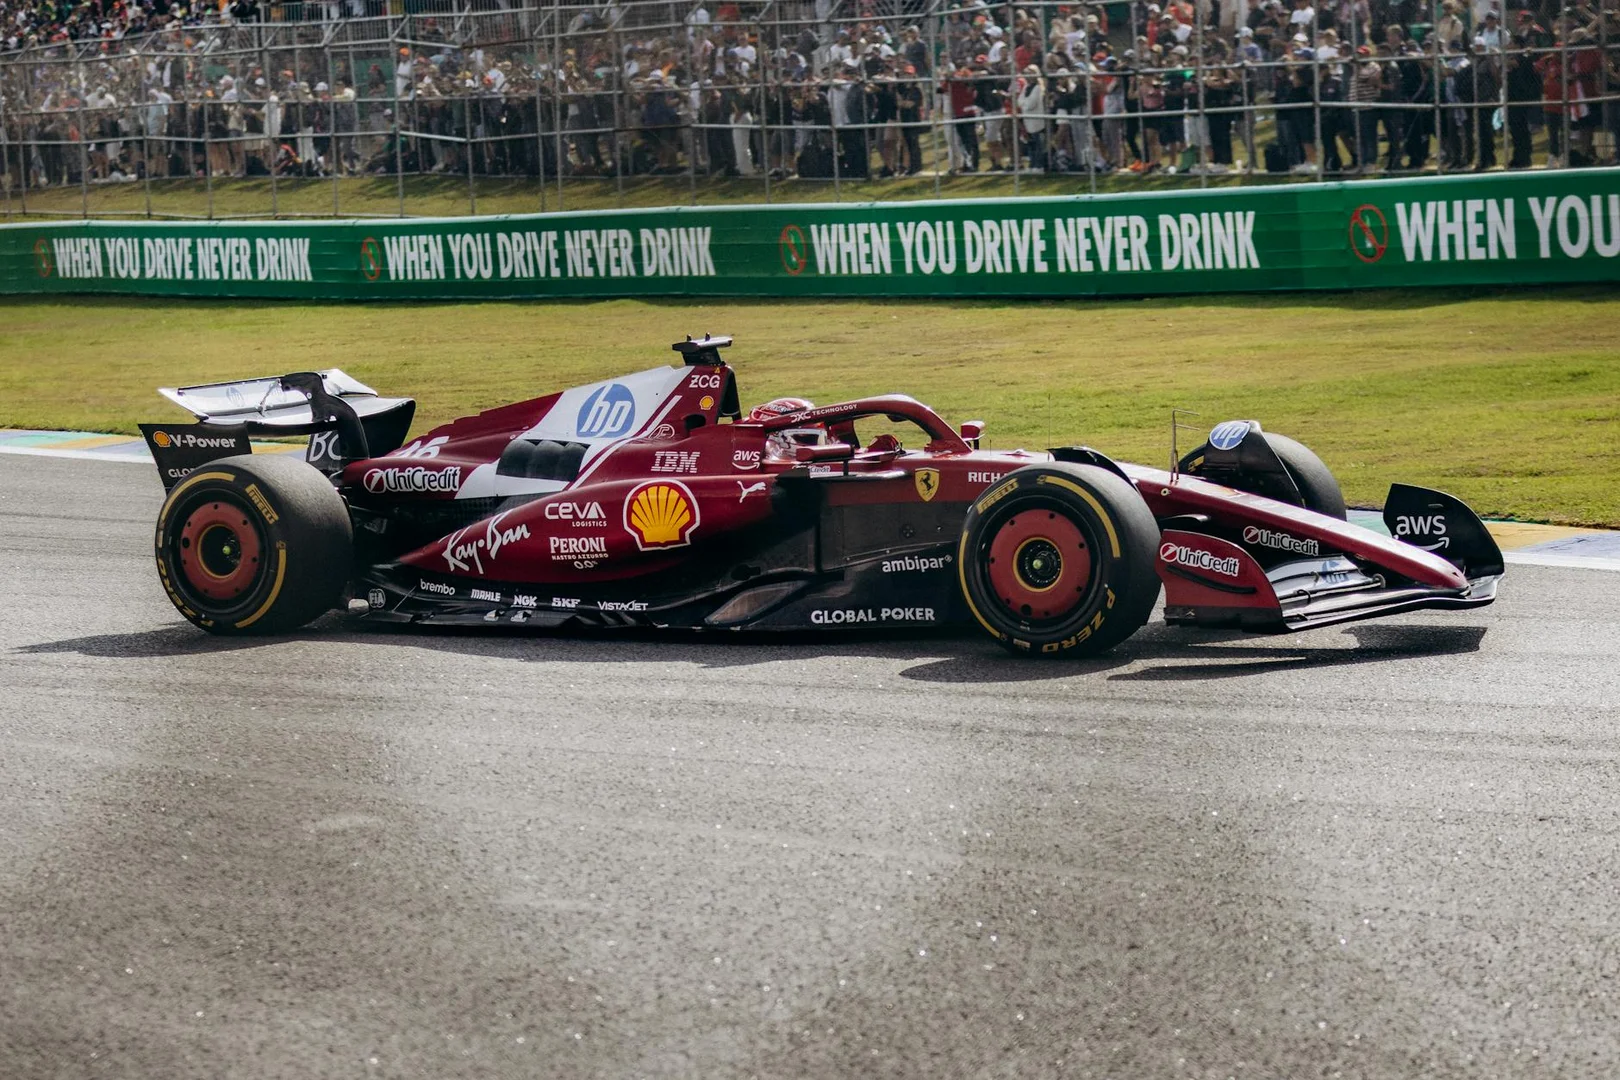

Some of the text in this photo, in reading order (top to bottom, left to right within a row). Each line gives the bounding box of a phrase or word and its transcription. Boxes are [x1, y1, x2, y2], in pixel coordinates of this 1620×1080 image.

[1395, 194, 1620, 262] WHEN YOU
[810, 211, 1260, 275] WHEN YOU DRIVE NEVER DRINK
[52, 237, 313, 281] WHEN YOU DRIVE NEVER DRINK
[383, 226, 716, 281] WHEN YOU DRIVE NEVER DRINK
[688, 374, 721, 389] ZCG
[580, 384, 634, 438] hp
[812, 403, 858, 417] TECHNOLOGY
[169, 433, 236, 448] V-Power
[1213, 422, 1246, 449] hp
[650, 451, 701, 474] IBM
[733, 450, 761, 461] aws
[384, 466, 461, 492] UniCredit
[571, 520, 608, 528] LOGISTICS
[1395, 515, 1448, 536] aws
[549, 536, 607, 554] PERONI
[1259, 529, 1319, 556] UniCredit
[578, 552, 609, 560] AZZURRO
[1177, 545, 1240, 577] UniCredit
[420, 578, 456, 596] brembo
[470, 588, 501, 602] MAHLE
[513, 594, 538, 607] NGK
[551, 597, 581, 608] SKF
[810, 607, 935, 624] GLOBAL POKER
[1041, 610, 1105, 654] ZERO
